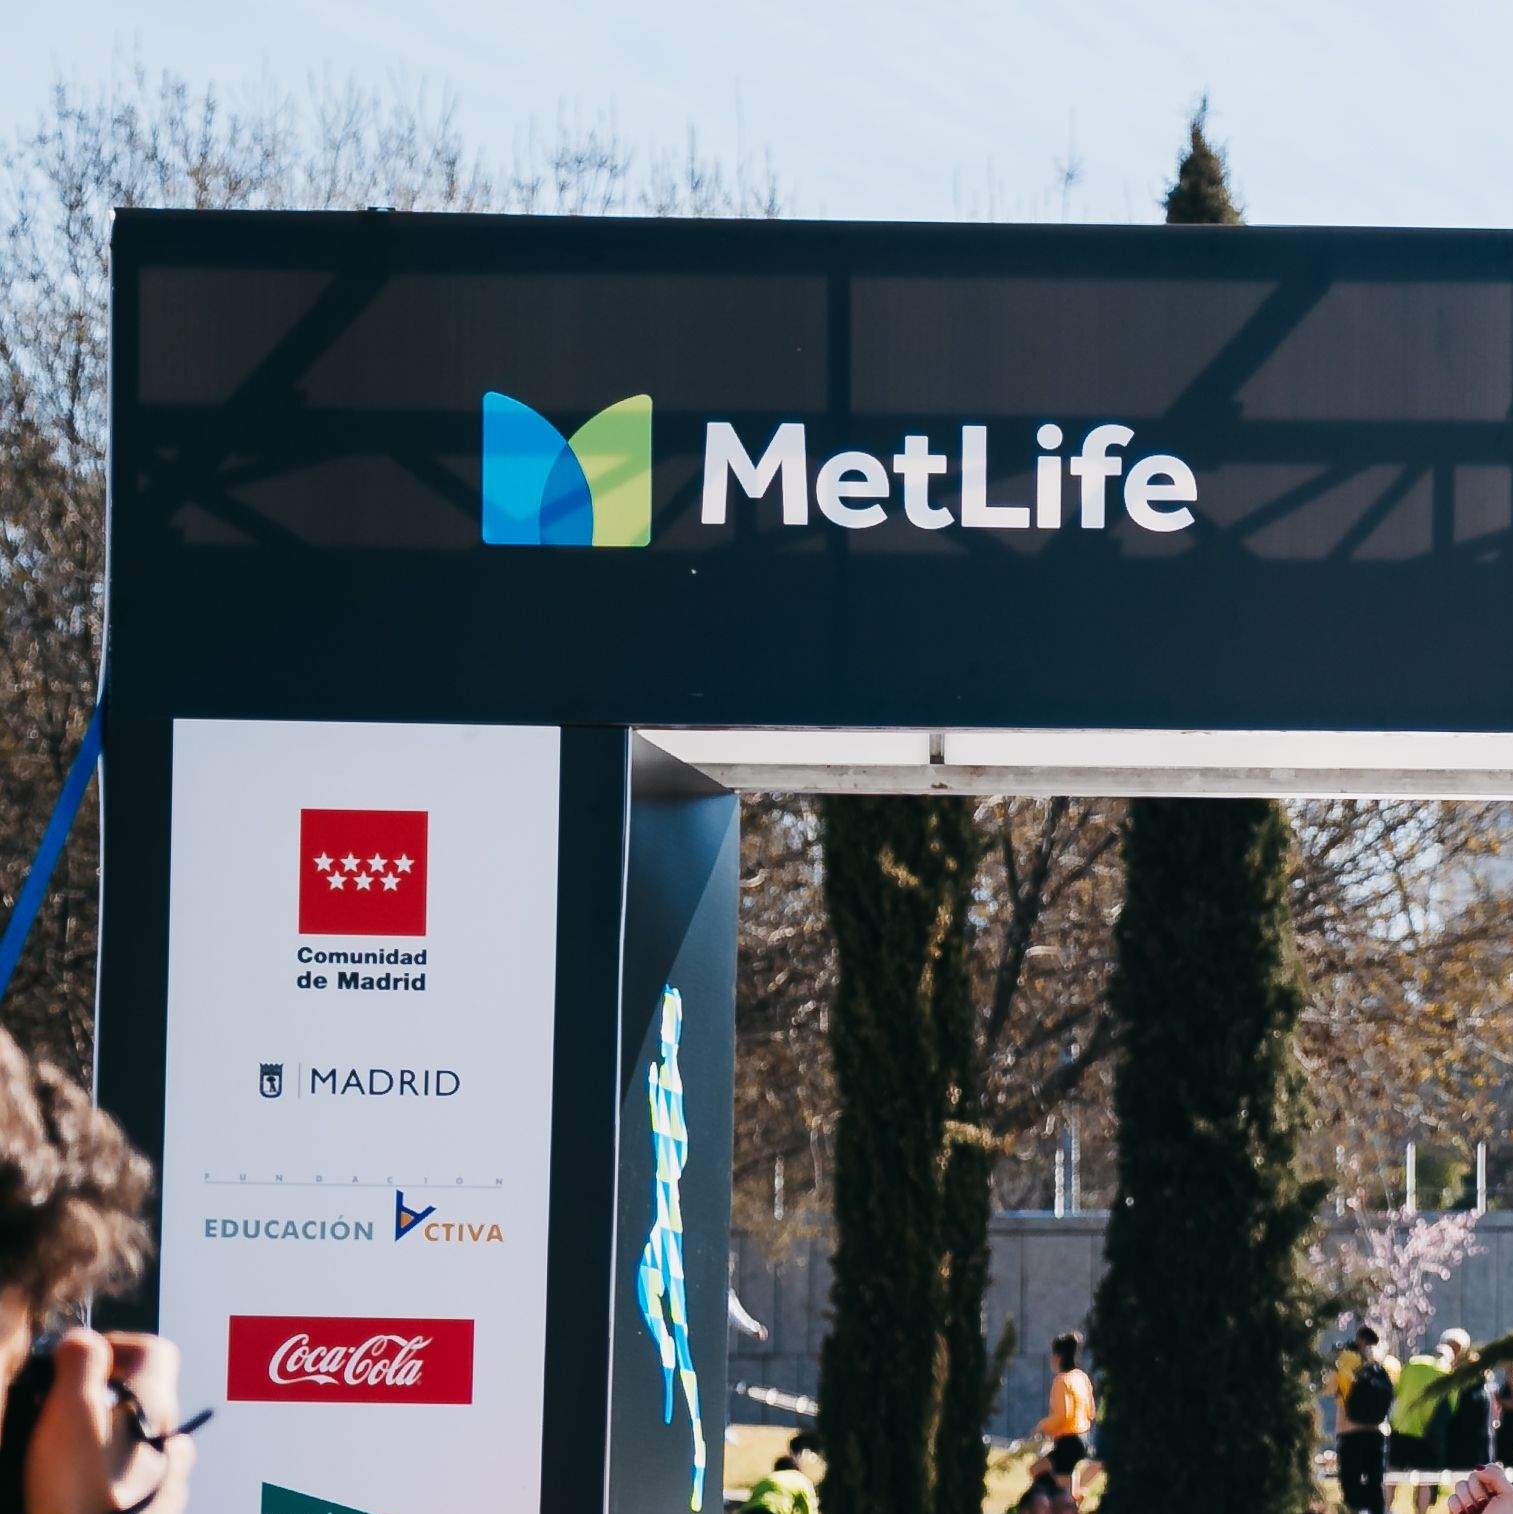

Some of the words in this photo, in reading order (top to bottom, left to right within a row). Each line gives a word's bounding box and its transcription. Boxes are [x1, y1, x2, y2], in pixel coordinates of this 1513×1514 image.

[701, 422, 1198, 531] MetLife
[297, 947, 428, 966] Comunidad
[297, 972, 329, 990] de
[337, 972, 427, 992] Madrid
[310, 1068, 461, 1097] MADRID
[204, 1215, 374, 1241] EDUCACIÓN
